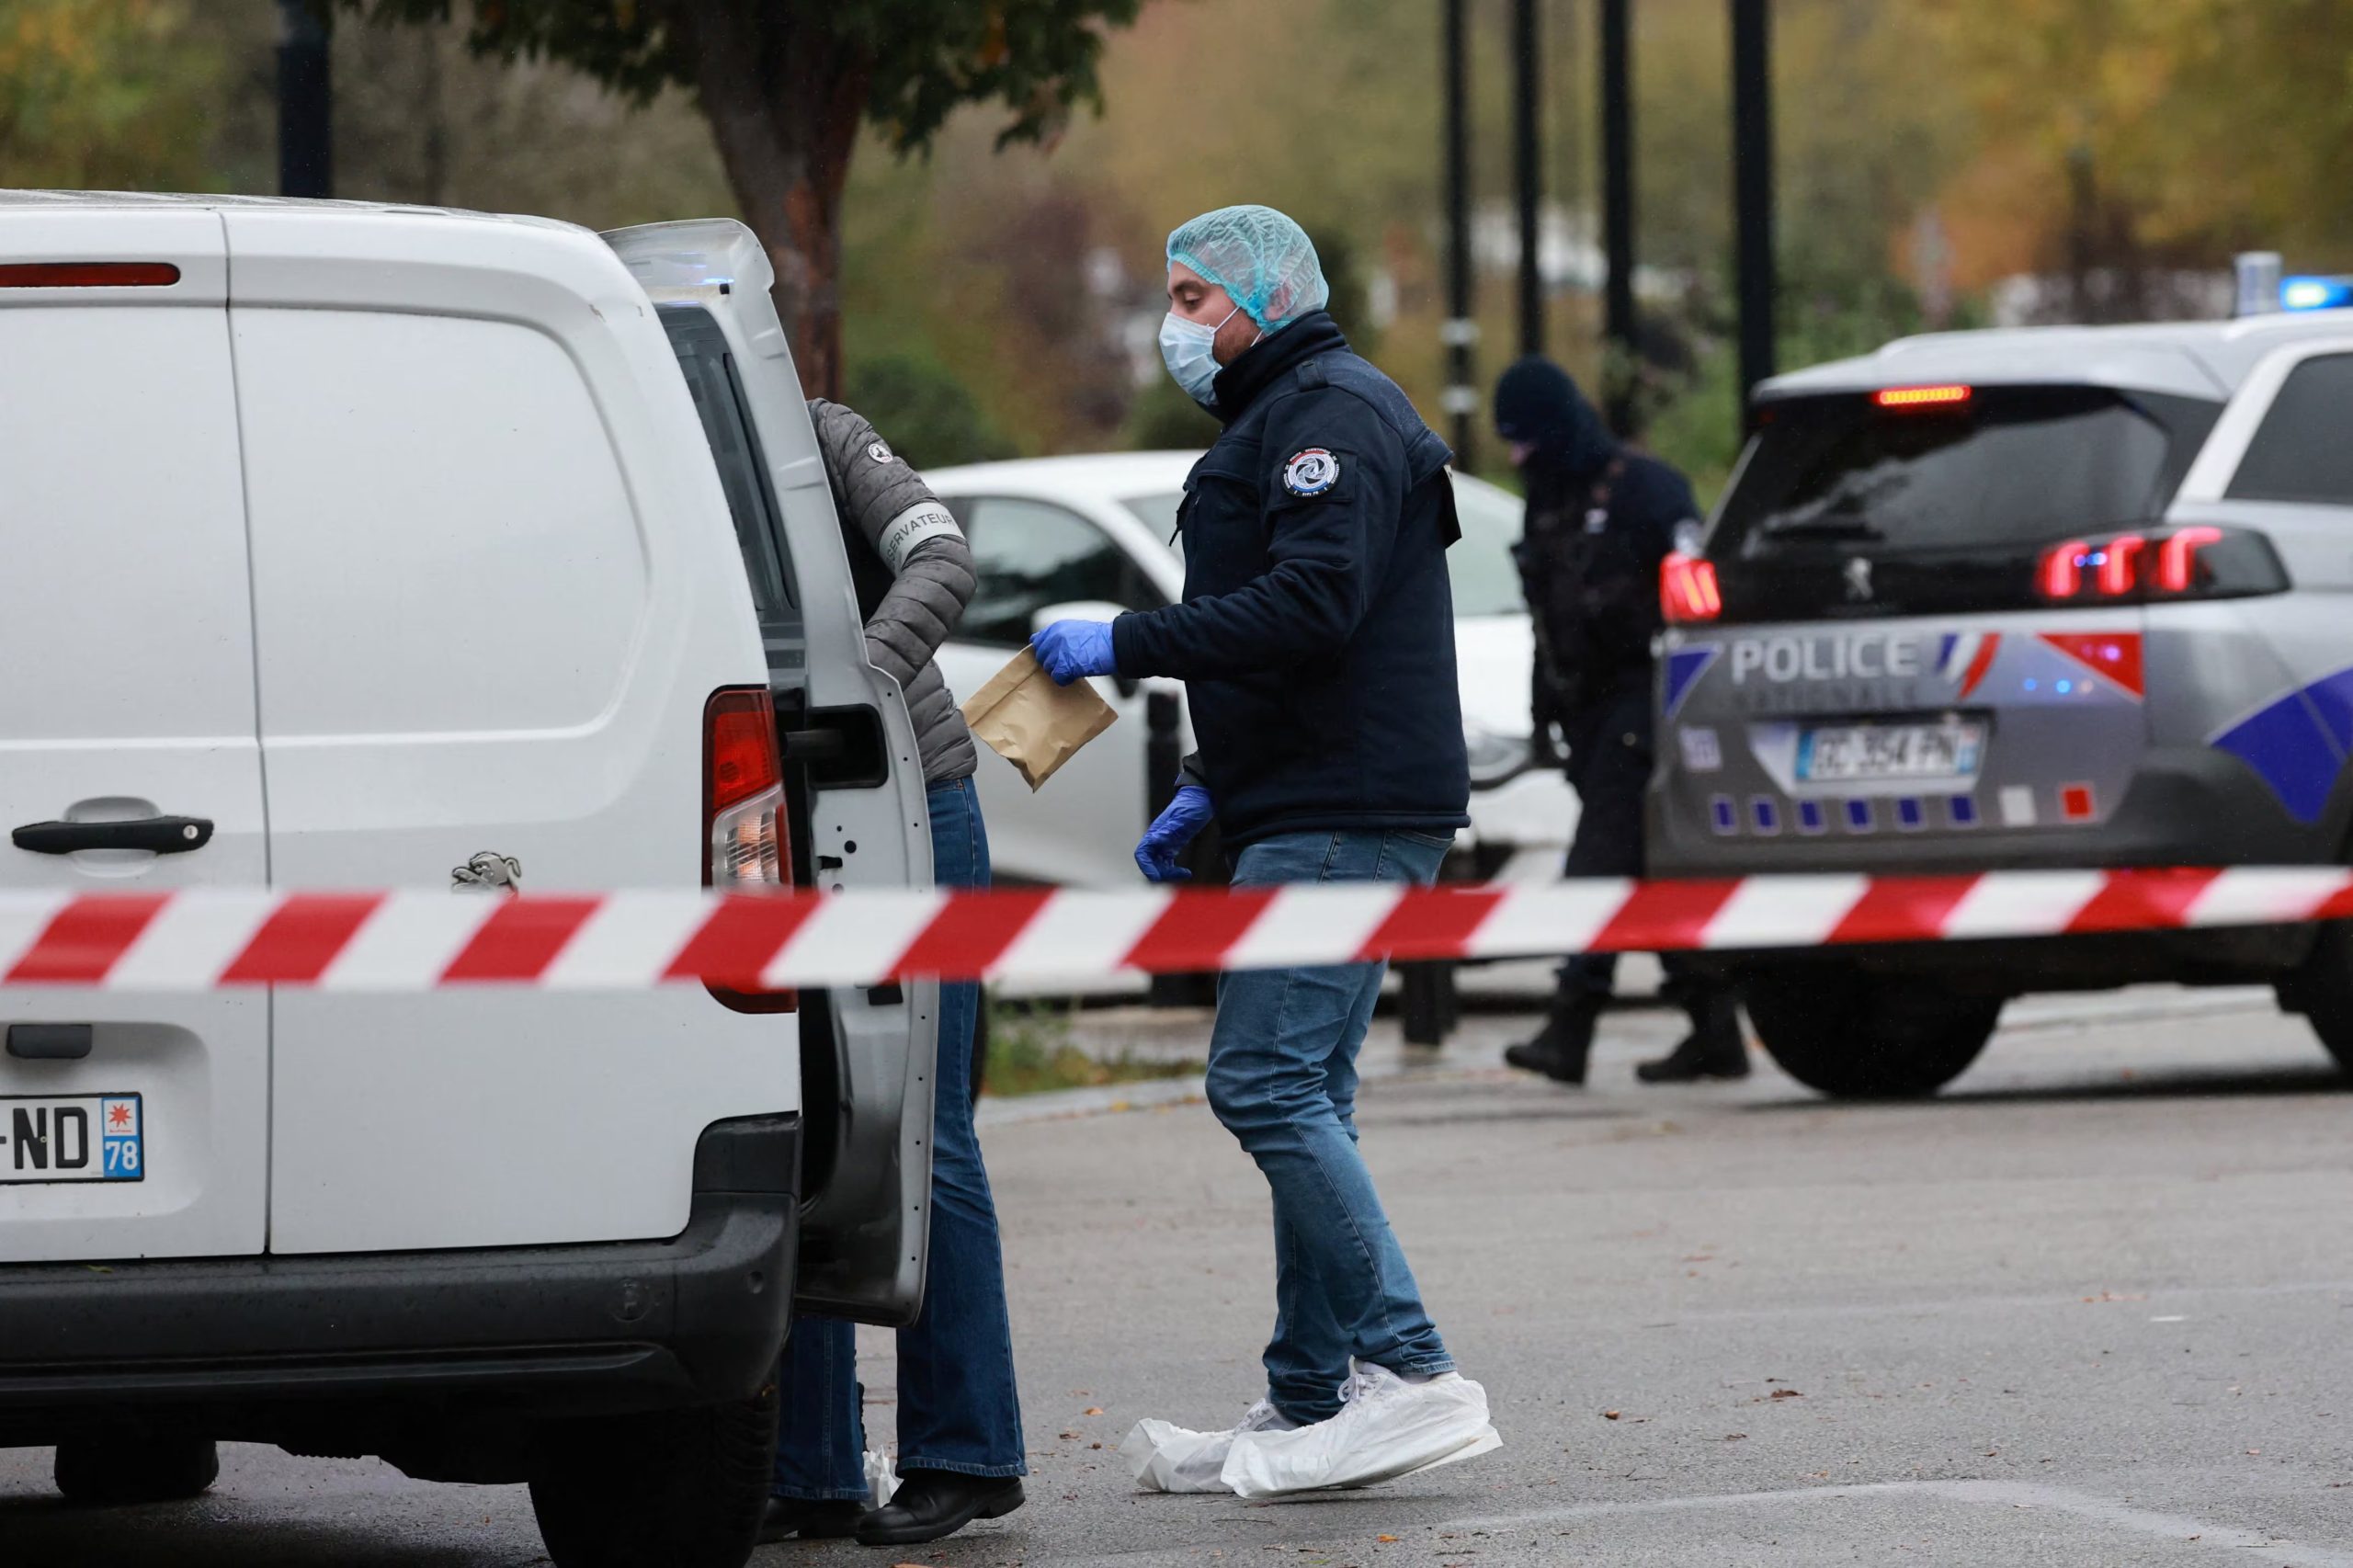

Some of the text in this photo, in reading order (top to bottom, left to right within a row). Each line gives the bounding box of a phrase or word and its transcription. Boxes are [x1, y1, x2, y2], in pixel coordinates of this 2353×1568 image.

[885, 513, 955, 562] SERVATEUR
[1732, 631, 1919, 686] POLICE
[104, 1141, 138, 1170] 78
